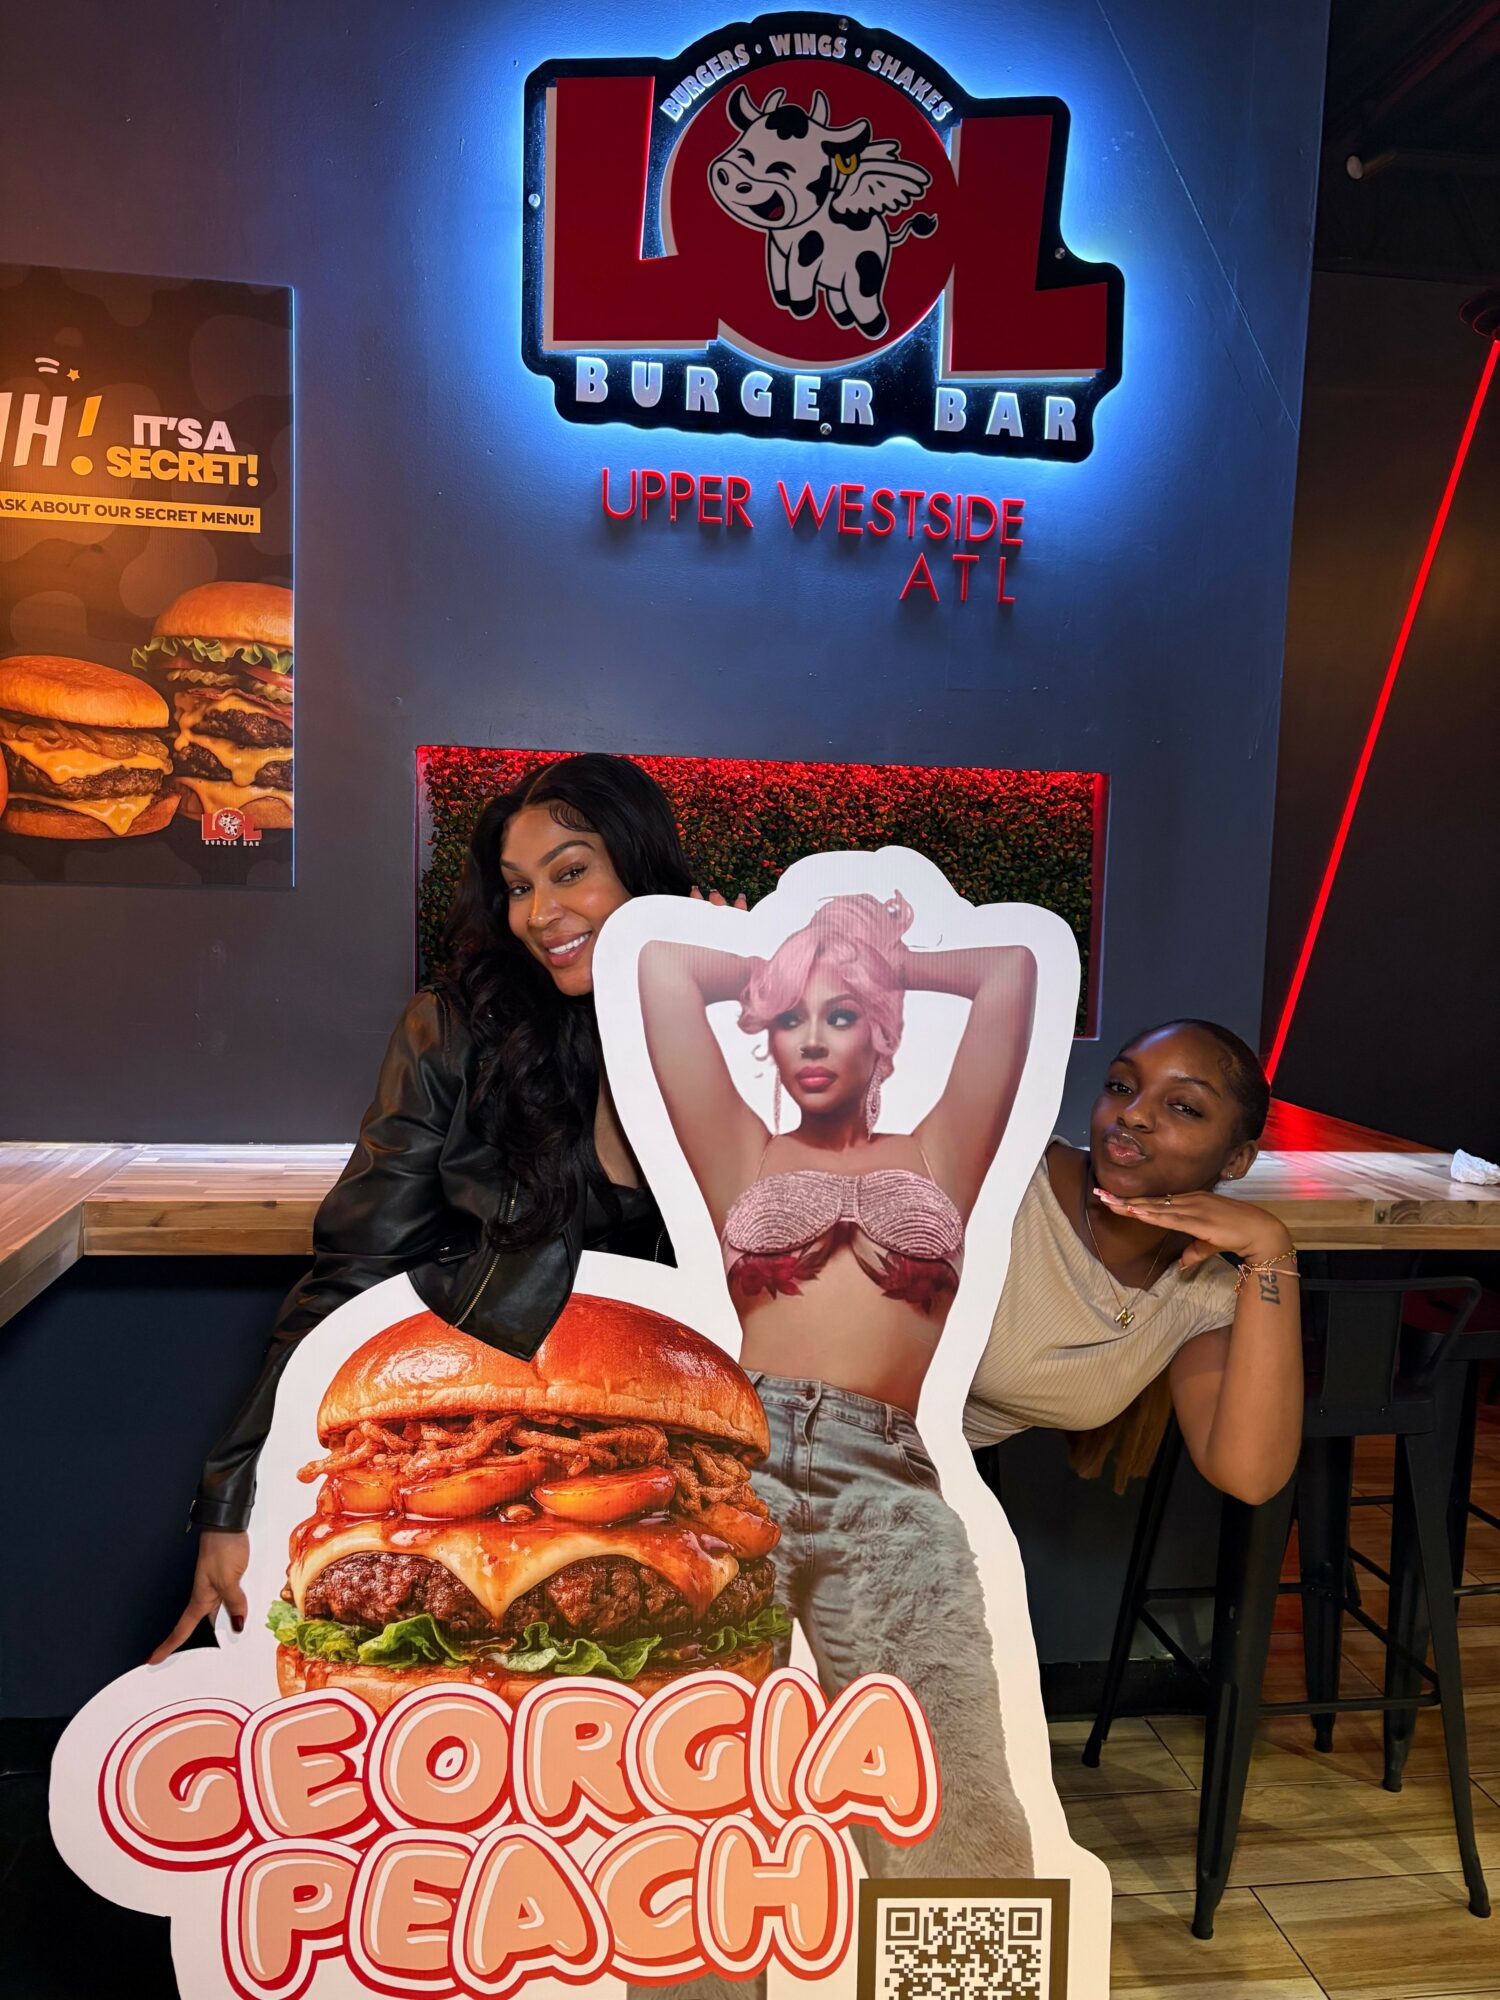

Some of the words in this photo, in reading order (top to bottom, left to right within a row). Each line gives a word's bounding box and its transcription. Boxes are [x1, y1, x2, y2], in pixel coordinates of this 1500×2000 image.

[660, 44, 750, 122] BURGERS
[769, 33, 848, 58] WINGS
[867, 50, 953, 121] SHAKES
[543, 59, 1108, 381] LOL
[133, 414, 202, 449] IT'S
[203, 420, 236, 452] A
[575, 356, 874, 426] BURGER
[934, 387, 1077, 441] BAR
[106, 446, 259, 487] SECRET!
[602, 467, 754, 529] UPPER
[777, 480, 1025, 546] WESTSIDE
[31, 500, 90, 516] ABOUT
[94, 504, 131, 519] OUR
[135, 507, 197, 523] SECRET
[201, 511, 254, 526] MENU!
[99, 1669, 942, 1872] GEORGIA
[221, 1813, 852, 2000] PEACH
